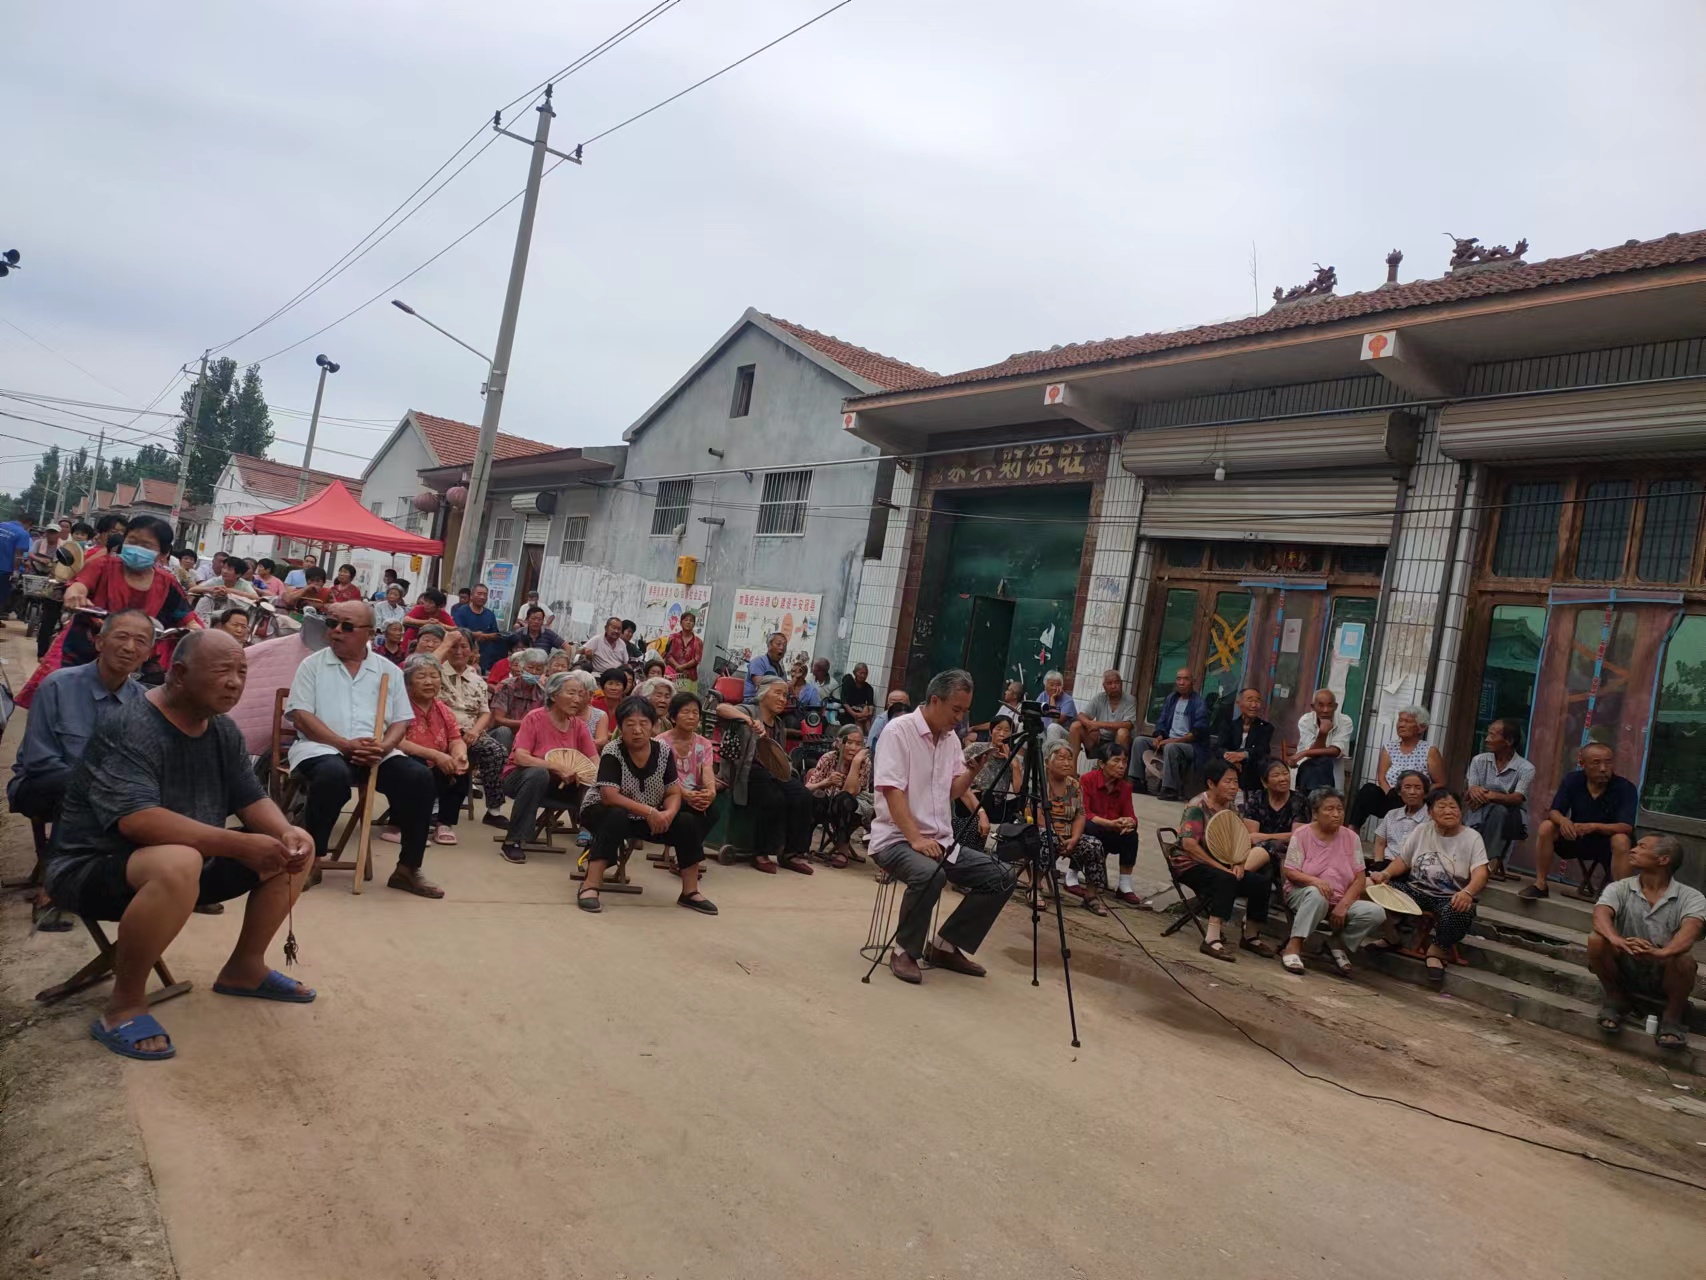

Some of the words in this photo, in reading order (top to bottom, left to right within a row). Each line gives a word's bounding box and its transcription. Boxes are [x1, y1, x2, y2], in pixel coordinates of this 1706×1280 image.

[738, 594, 771, 608] 加强综合治理
[779, 597, 816, 612] 建设平安冠县
